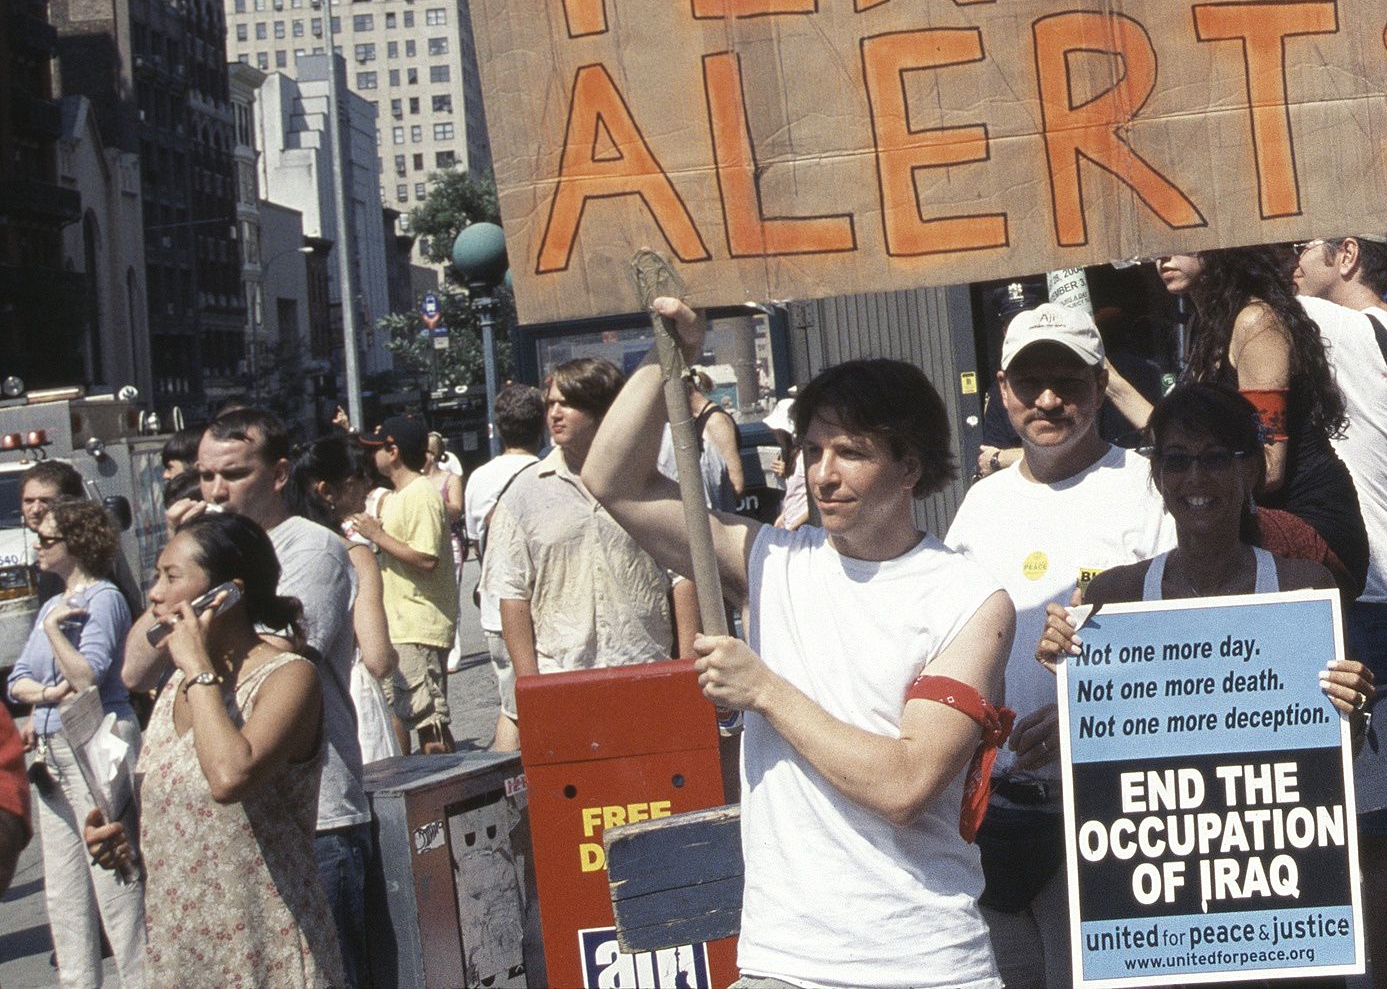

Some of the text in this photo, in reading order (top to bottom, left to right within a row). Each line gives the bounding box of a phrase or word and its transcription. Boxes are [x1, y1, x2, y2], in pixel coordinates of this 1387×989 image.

[1076, 634, 1261, 667] Not one more day.
[1077, 668, 1285, 703] Not one more death.
[1079, 702, 1330, 739] Not one more deception.
[1120, 761, 1301, 814] END THE
[1078, 804, 1346, 862] OCCUPATION
[1131, 854, 1301, 911] OF IRAQ
[1086, 913, 1350, 951] united for peace & justice
[1123, 947, 1316, 971] www.unitedforpeace.org
